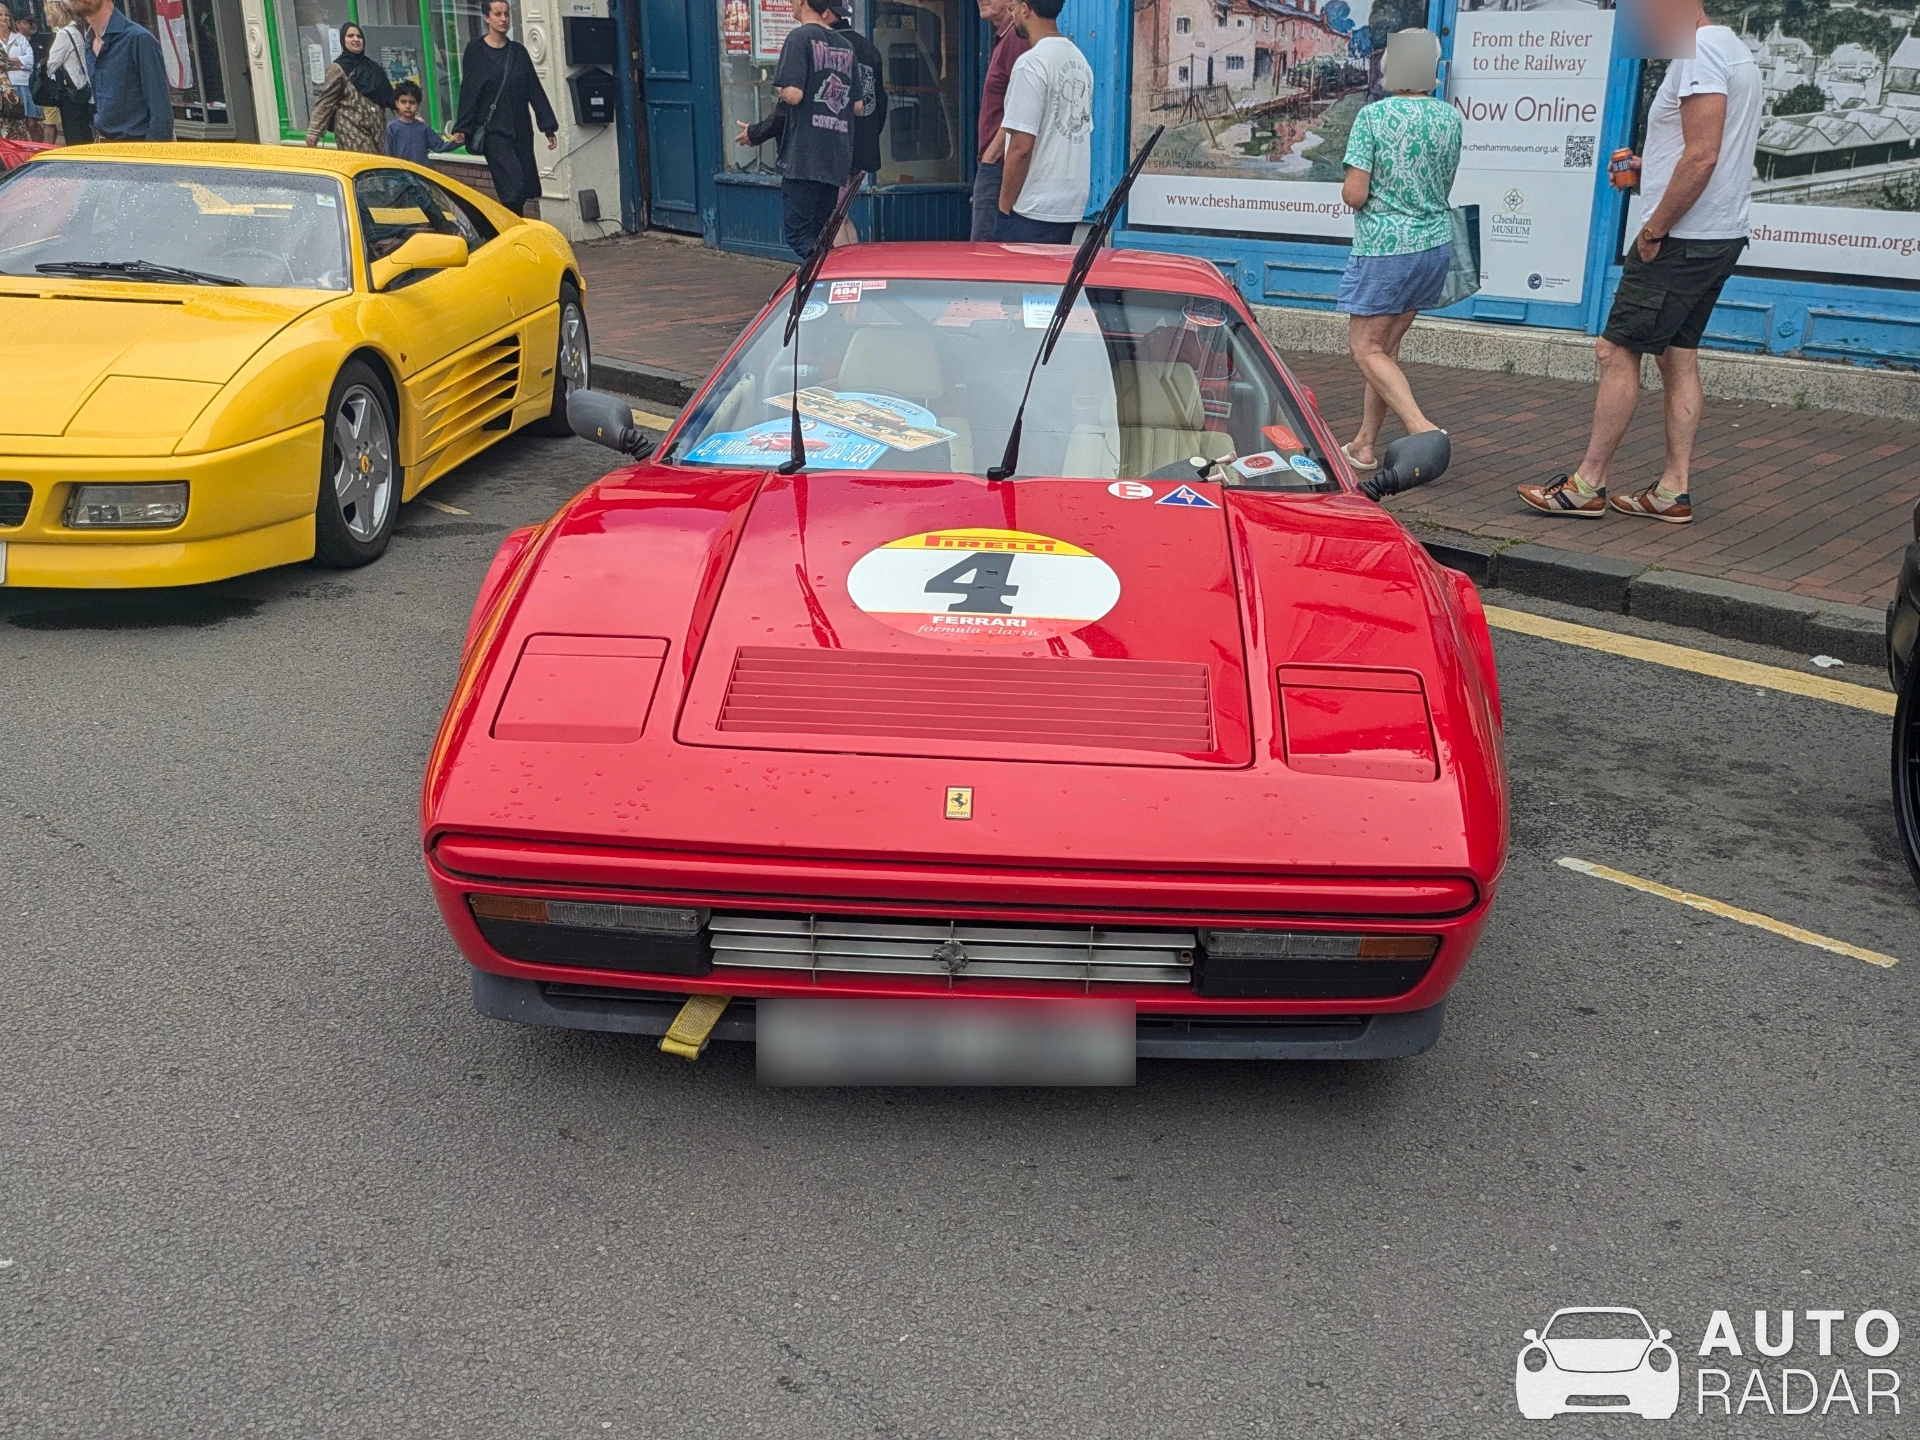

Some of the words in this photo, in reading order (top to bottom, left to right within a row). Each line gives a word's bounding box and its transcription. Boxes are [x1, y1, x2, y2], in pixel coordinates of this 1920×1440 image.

[1472, 31, 1513, 47] From
[1518, 30, 1545, 47] the
[1550, 30, 1593, 47] River
[1473, 55, 1489, 70] to
[1494, 54, 1519, 70] the
[1524, 54, 1587, 76] Railway
[1454, 96, 1508, 121] Now
[1514, 96, 1597, 122] Online
[1461, 143, 1559, 154] w.cheshammuseum.org.uk
[1491, 214, 1532, 225] Chesham
[1491, 225, 1530, 235] MUSEUM
[834, 287, 858, 295] 404
[822, 443, 848, 460] LA
[842, 444, 881, 464] 328
[1118, 484, 1144, 499] E
[925, 535, 1057, 551] PIRELLI
[924, 552, 1019, 614] 4
[932, 615, 1027, 627] FERRARI
[916, 624, 981, 634] formula
[988, 626, 1042, 637] classic
